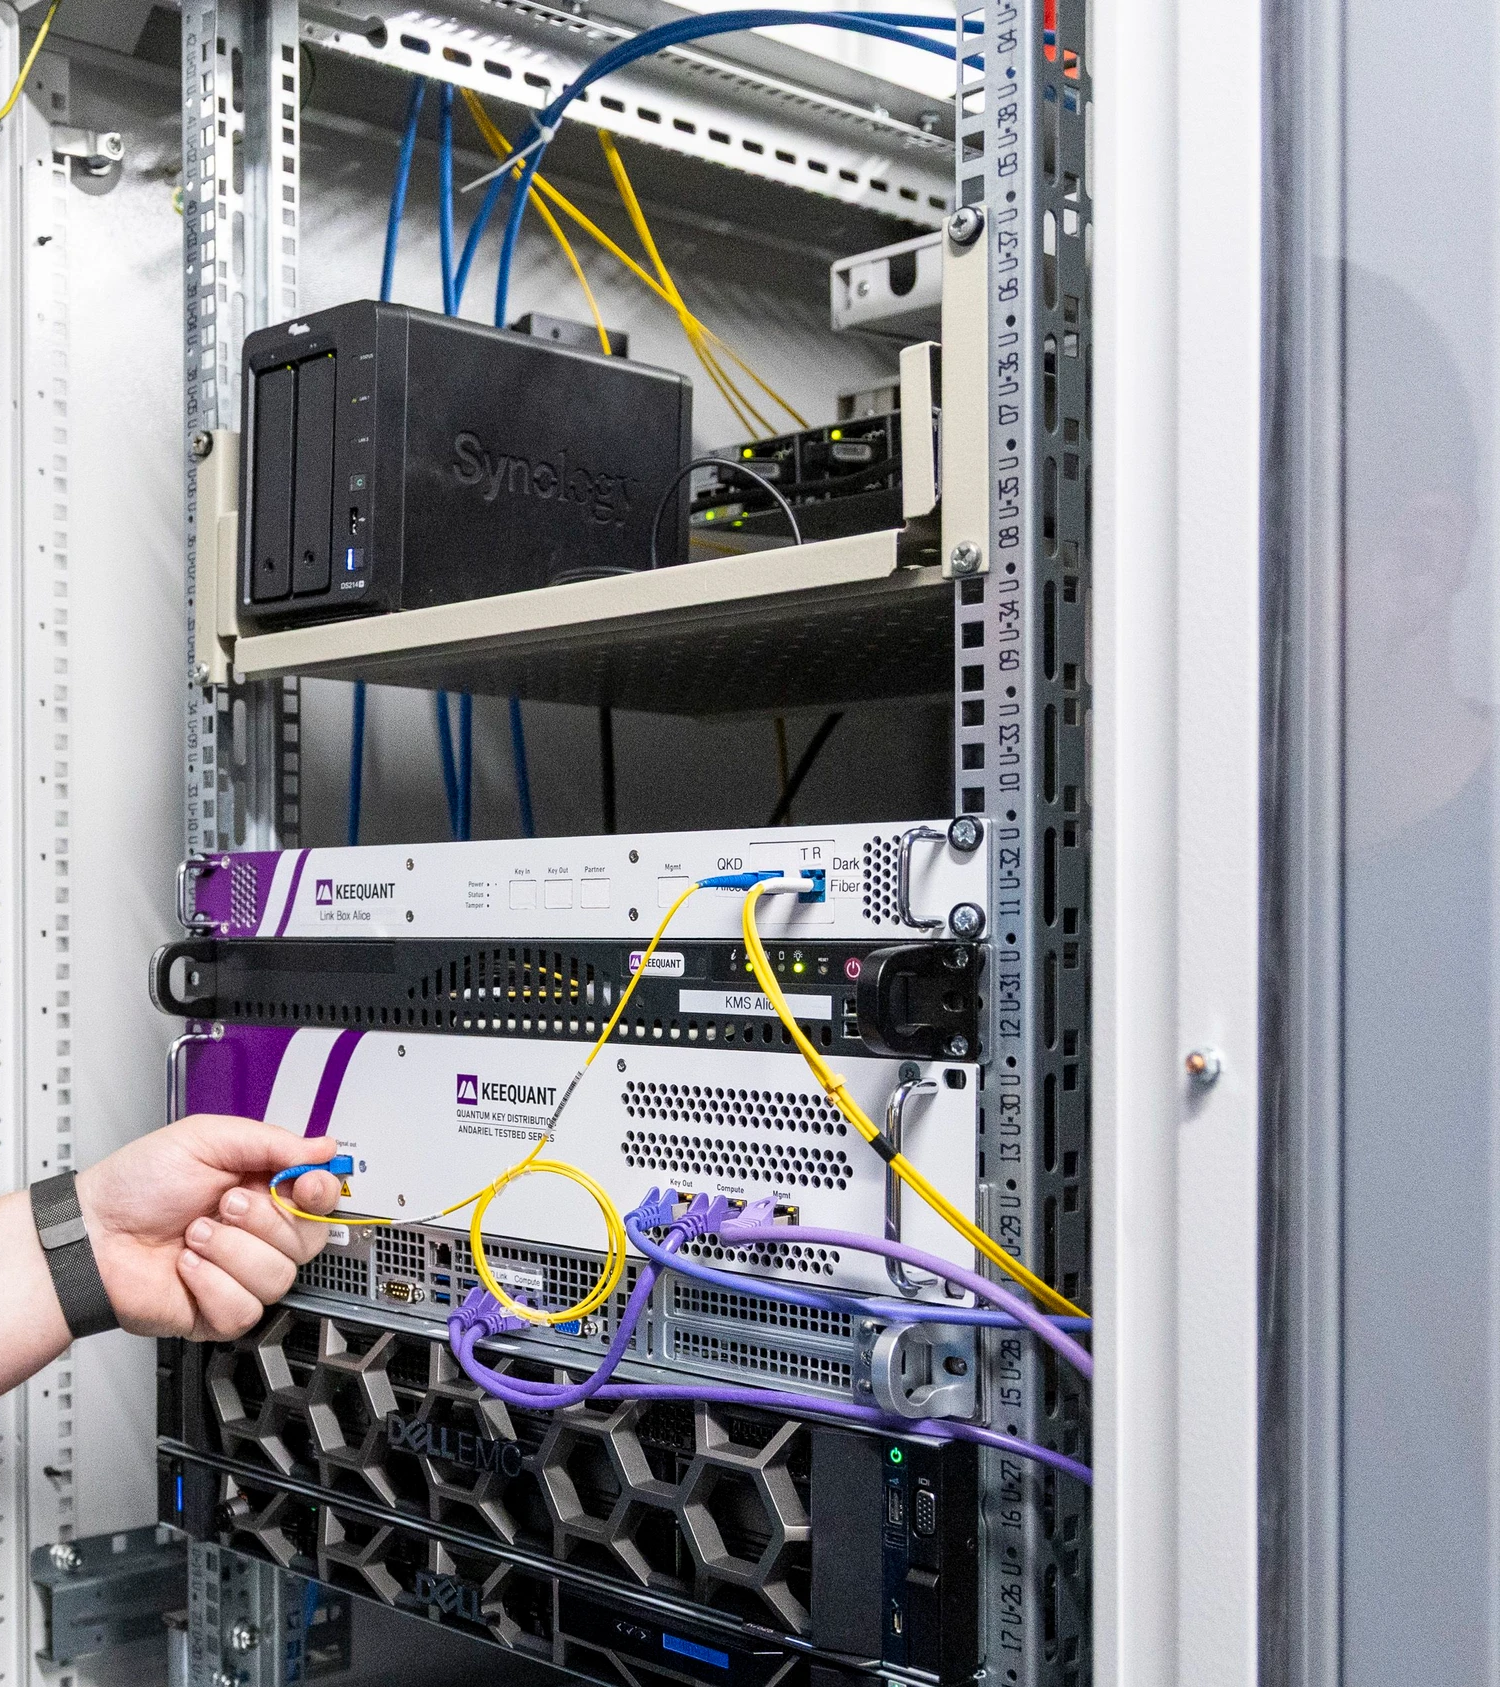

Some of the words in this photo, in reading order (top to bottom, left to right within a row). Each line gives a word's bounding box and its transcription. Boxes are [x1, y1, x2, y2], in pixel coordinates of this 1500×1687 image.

[452, 430, 639, 527] Synology
[812, 846, 821, 859] R
[665, 863, 681, 872] Mgmt
[717, 857, 743, 871] QKD
[832, 857, 860, 870] Dark
[514, 868, 524, 876] Key
[547, 867, 558, 876] Key
[559, 866, 569, 874] Out
[336, 883, 395, 901] KEEQUANT
[830, 879, 860, 892] Fiber
[465, 902, 484, 910] Tamper
[320, 910, 334, 921] Link
[337, 911, 350, 921] Box
[353, 910, 371, 921] Alice
[725, 996, 751, 1009] KMS
[755, 997, 776, 1011] Alic
[482, 1082, 557, 1106] KEEQUANT
[456, 1109, 490, 1121] QUANTUM
[492, 1112, 505, 1122] KEY
[458, 1125, 493, 1136] ANDARIEL
[495, 1128, 526, 1140] TESTBED
[670, 1178, 681, 1188] Key
[682, 1179, 693, 1188] Out
[717, 1184, 745, 1194] Compute
[772, 1190, 791, 1199] Mgmt
[514, 1274, 541, 1287] Compute
[416, 1571, 487, 1626] DELL
